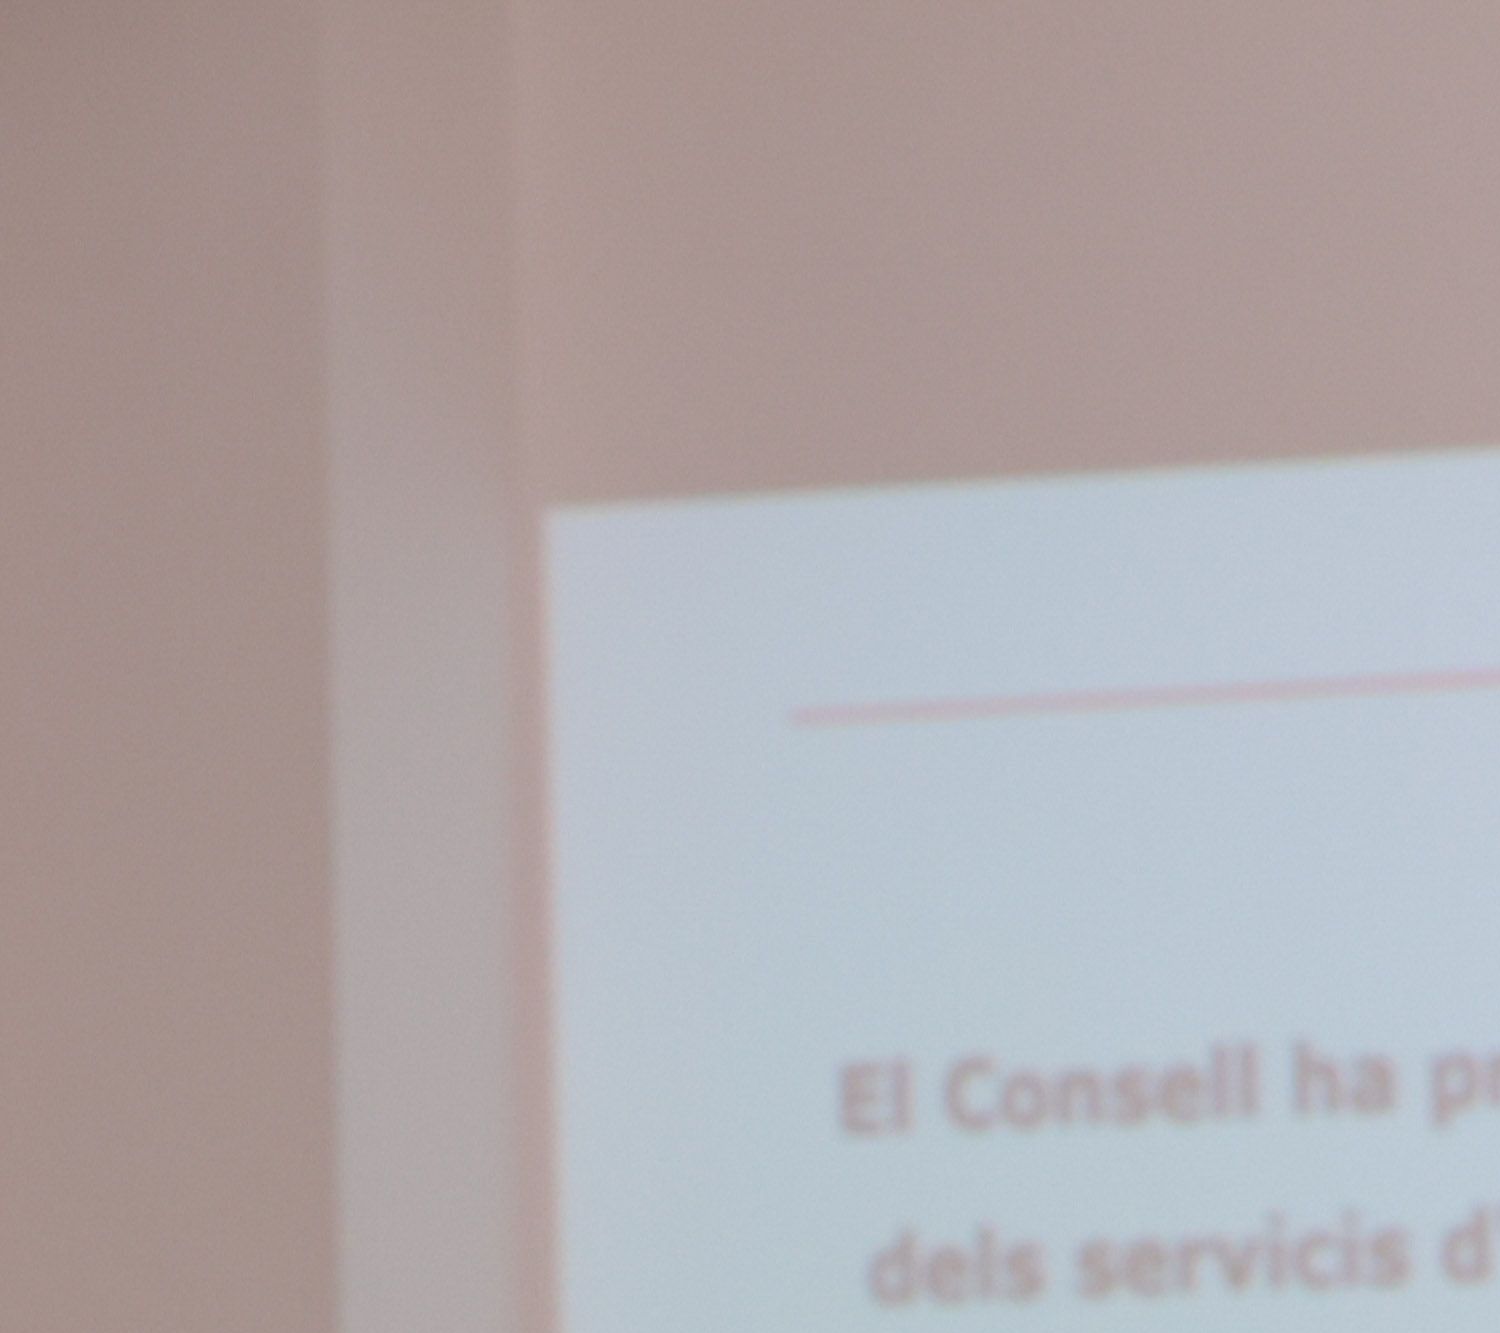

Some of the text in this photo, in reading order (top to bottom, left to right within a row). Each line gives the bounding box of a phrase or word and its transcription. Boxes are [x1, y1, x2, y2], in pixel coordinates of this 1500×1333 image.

[836, 1060, 914, 1138] El
[940, 1044, 1262, 1133] Consell
[1290, 1038, 1400, 1116] ha
[864, 1223, 1048, 1308] dels
[1073, 1212, 1414, 1301] servicis
